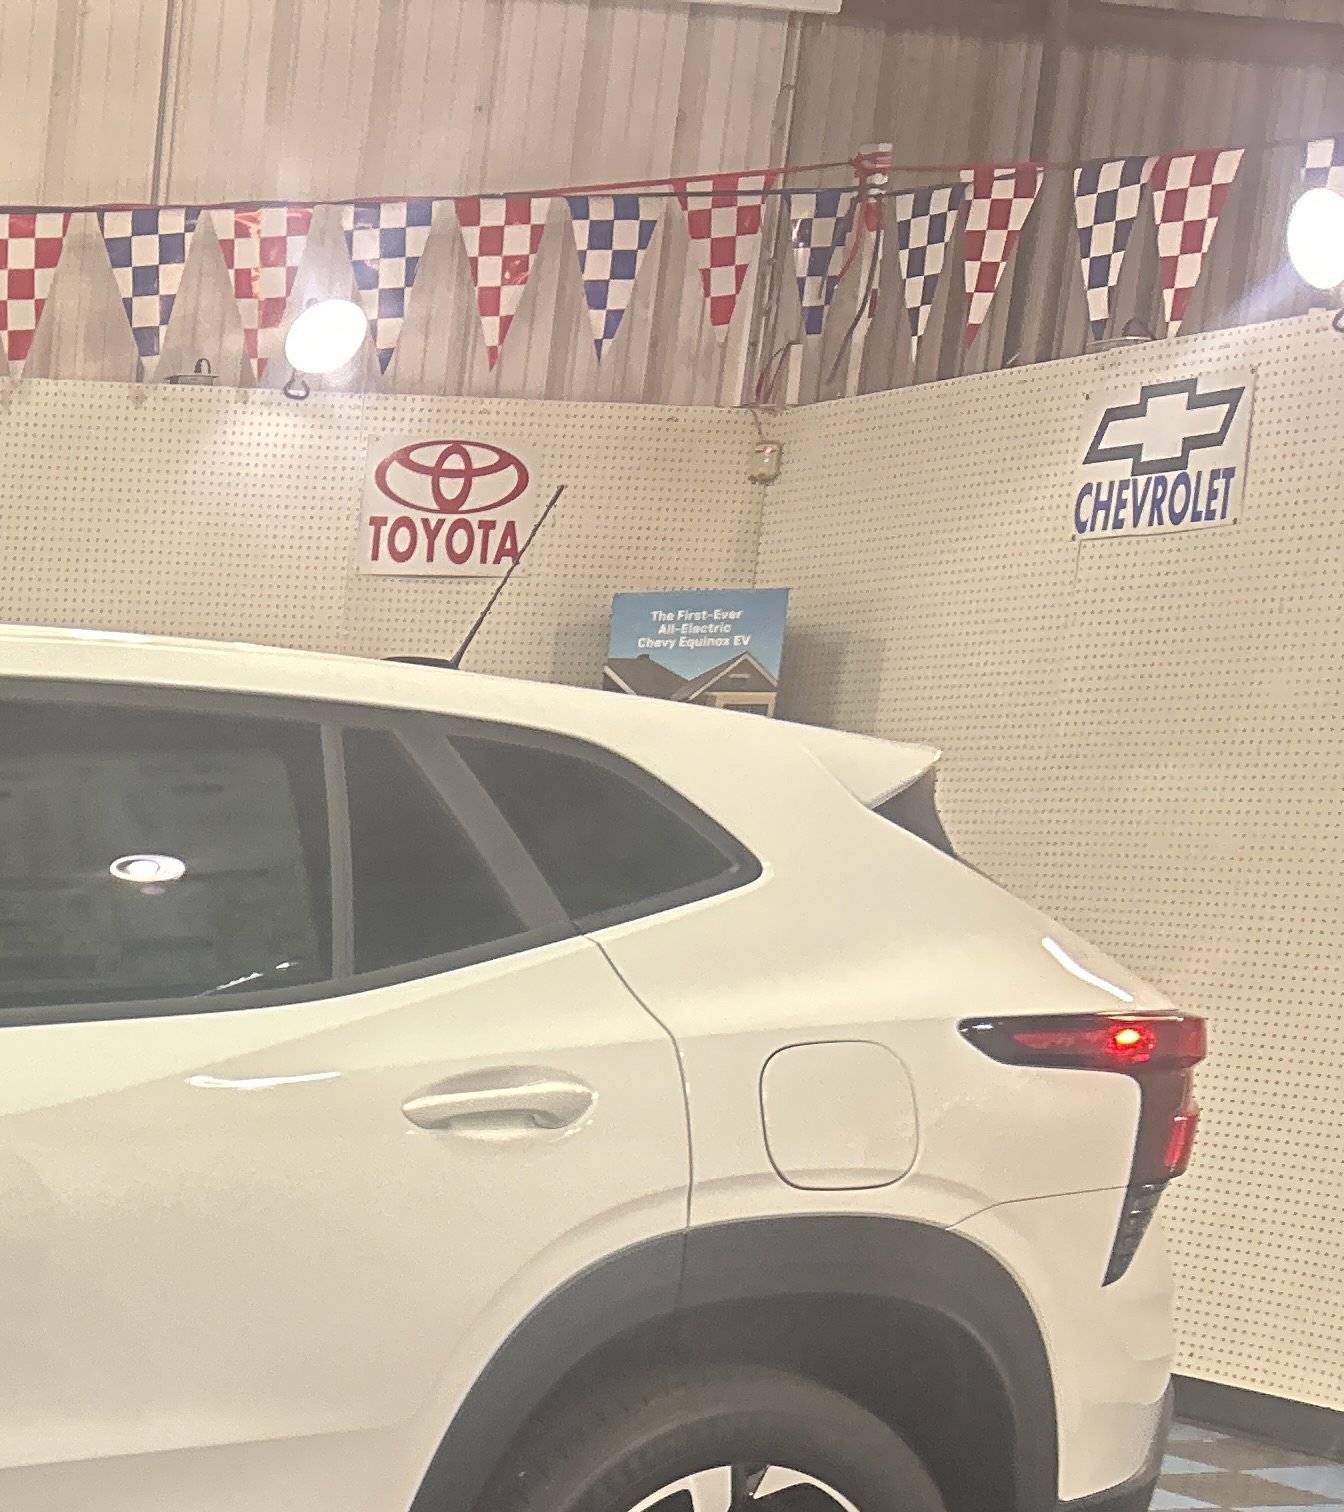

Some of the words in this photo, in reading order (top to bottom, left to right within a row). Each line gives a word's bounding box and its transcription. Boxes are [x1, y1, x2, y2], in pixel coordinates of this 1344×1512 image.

[1074, 466, 1236, 535] CHEVROLET
[368, 515, 520, 565] TOYOTA
[650, 610, 674, 621] The
[676, 608, 744, 621] First-Ever
[658, 621, 732, 634] All-Electric
[638, 637, 676, 649] Chevy
[678, 635, 730, 649] Equinox
[733, 635, 752, 646] EV
